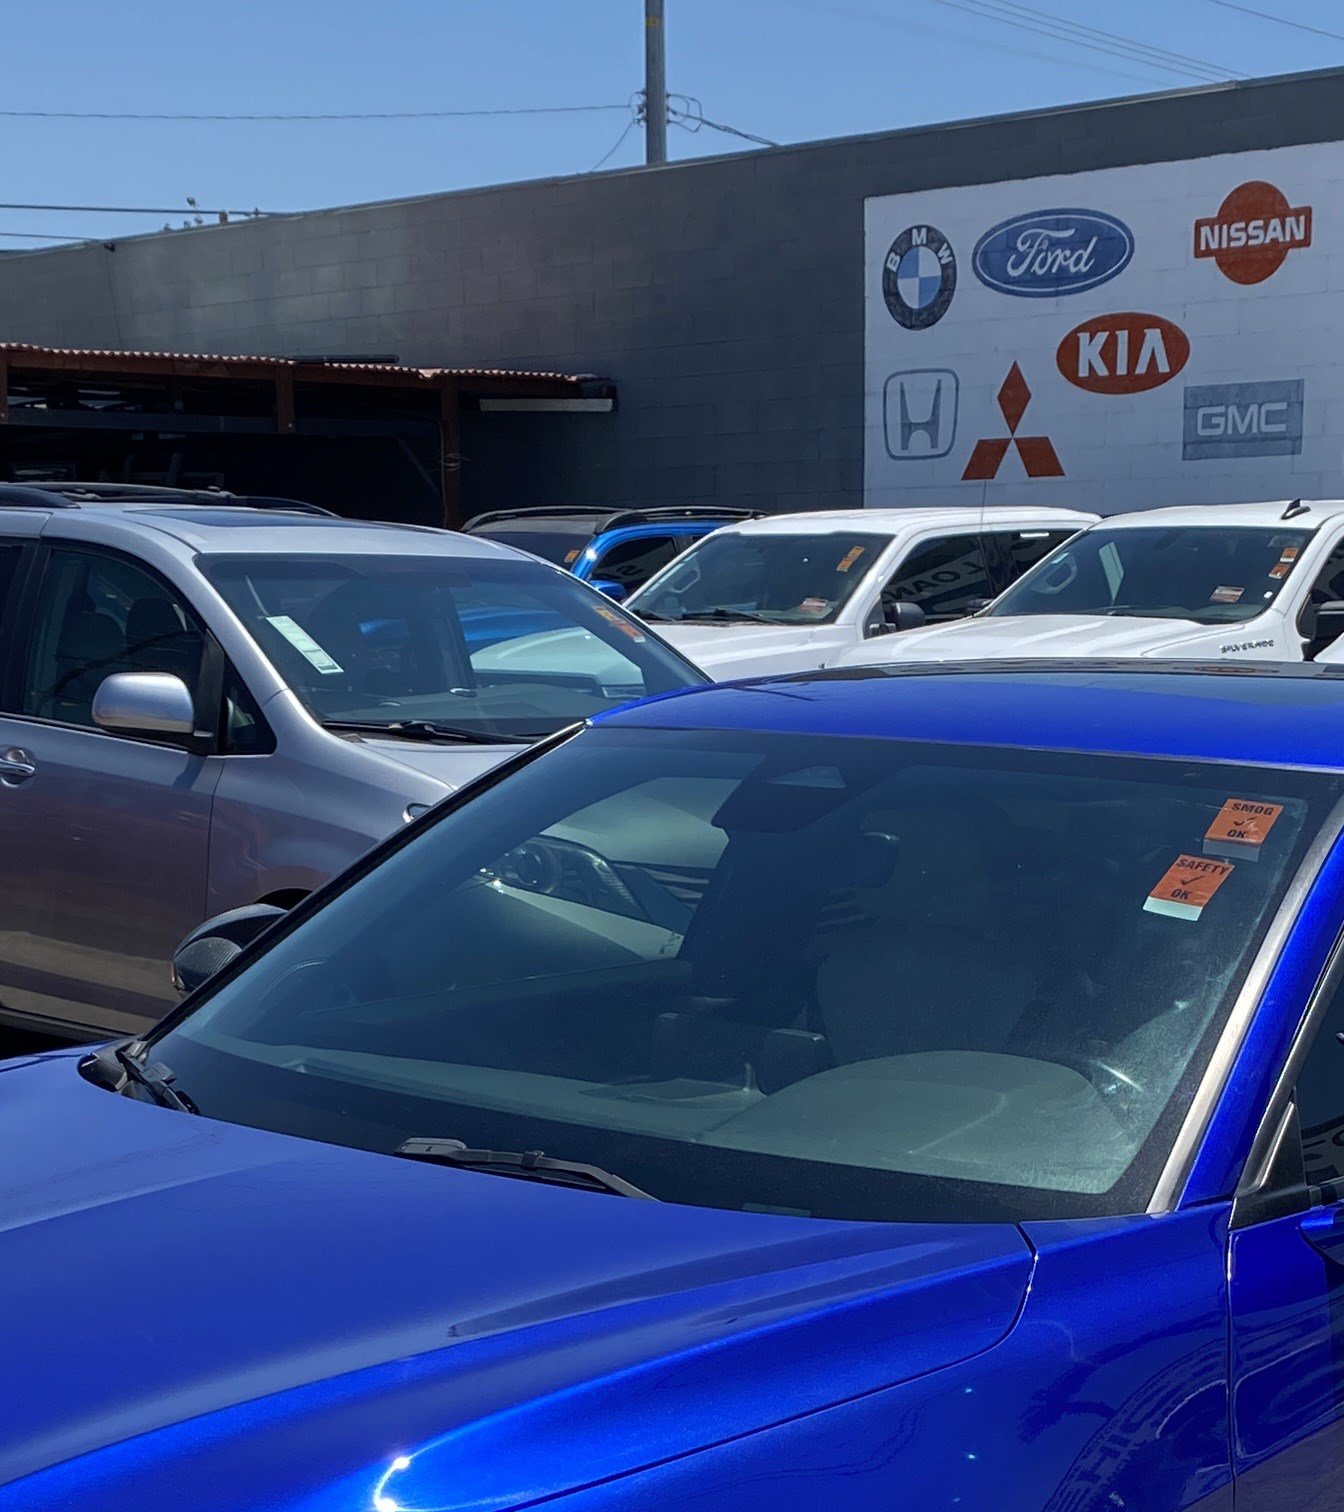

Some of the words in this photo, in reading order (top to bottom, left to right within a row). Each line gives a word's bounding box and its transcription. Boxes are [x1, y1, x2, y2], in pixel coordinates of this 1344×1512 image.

[887, 227, 953, 272] BMW
[1200, 216, 1305, 251] NISSAN
[1006, 228, 1097, 277] Ford
[1077, 328, 1171, 378] KIA
[1196, 401, 1288, 437] GMC
[1231, 802, 1274, 816] SMOG
[1226, 829, 1246, 839] OK
[1176, 858, 1230, 876] SAFETY
[1171, 889, 1192, 901] OK
